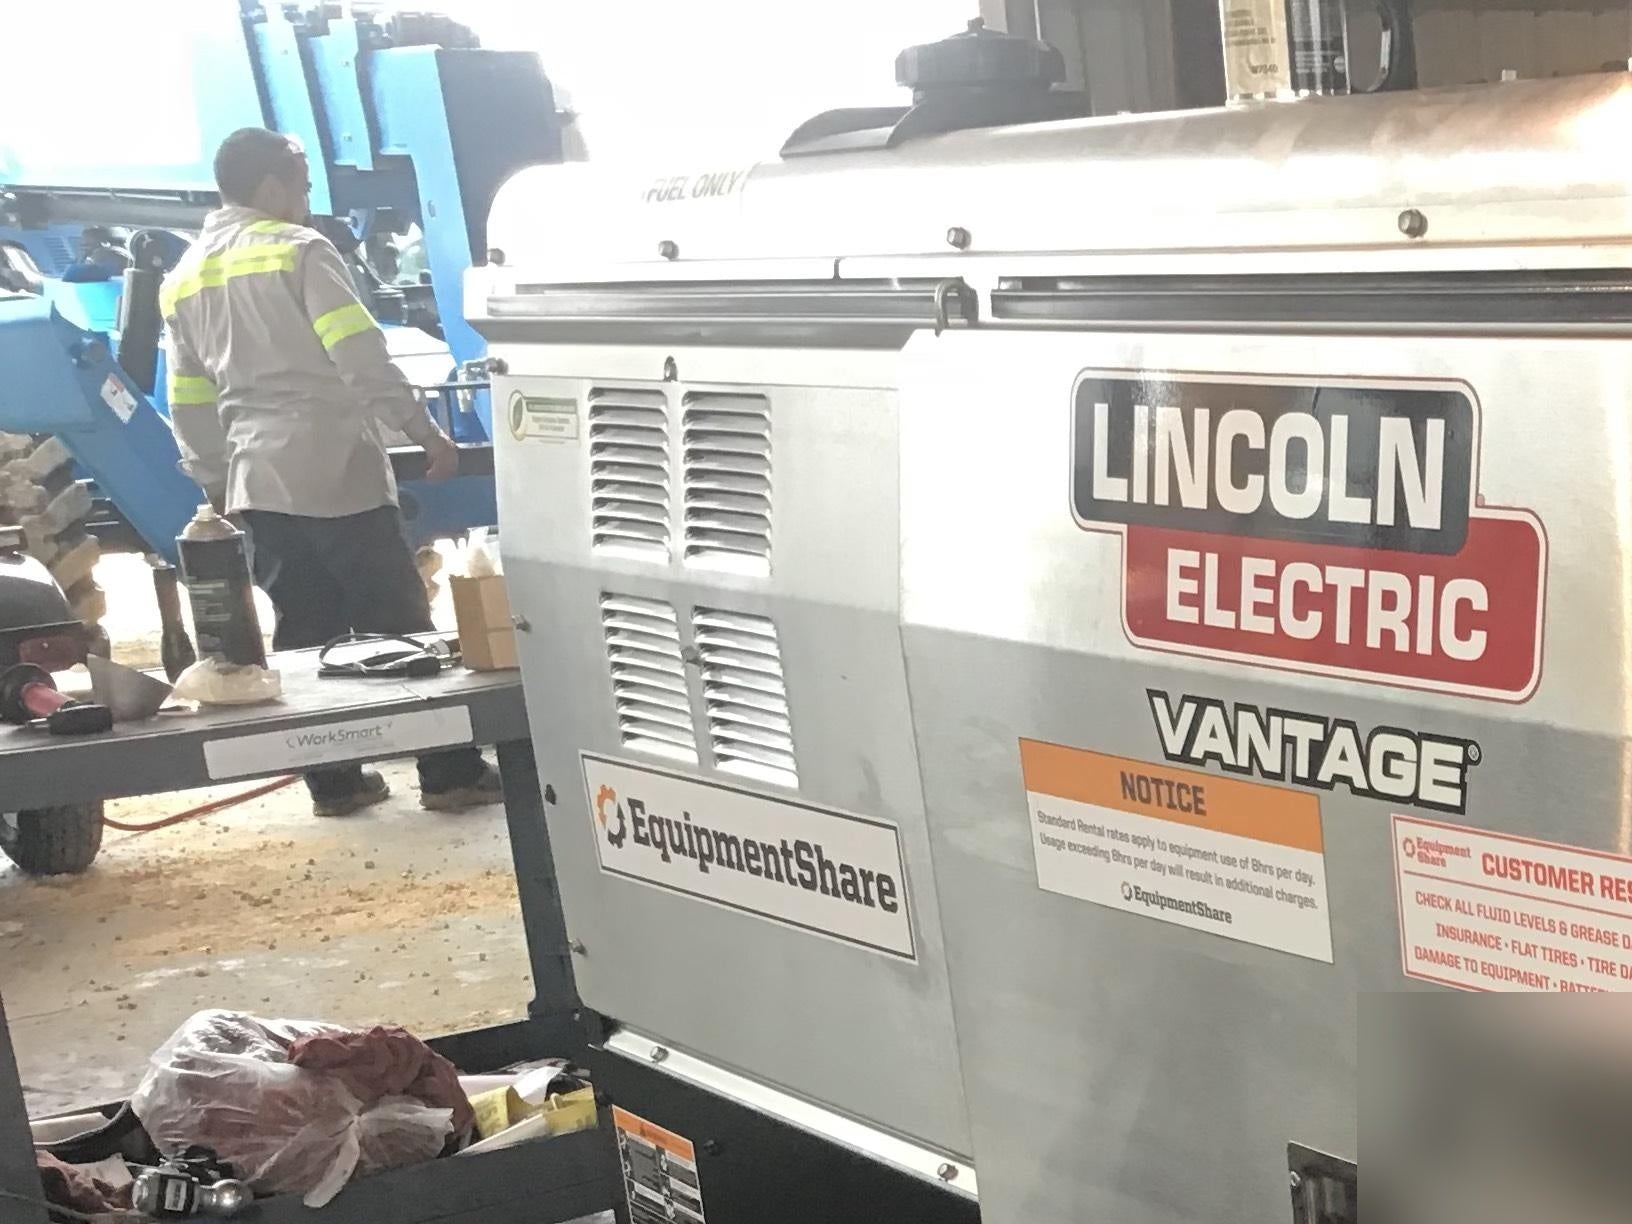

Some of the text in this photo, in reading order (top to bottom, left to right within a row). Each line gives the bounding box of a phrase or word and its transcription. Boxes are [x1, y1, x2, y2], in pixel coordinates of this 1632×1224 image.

[692, 170, 744, 198] ONLY
[1093, 402, 1446, 530] LINCOLN
[1166, 547, 1489, 662] ELECTRIC
[296, 725, 383, 747] WorkSmart
[1120, 771, 1207, 816] NOTICE
[627, 797, 899, 914] EquipmentShare
[1037, 810, 1076, 831] Standard
[1077, 819, 1105, 837] Rental
[1131, 834, 1155, 851] apply
[1157, 838, 1167, 852] to
[1169, 842, 1217, 864] equipment
[1220, 855, 1237, 868] use
[1239, 857, 1249, 869] of
[1251, 858, 1274, 876] 8hrs
[1276, 867, 1292, 880] per
[1295, 868, 1316, 887] day.
[1417, 837, 1471, 858] Equipment
[1417, 851, 1447, 867] Share
[1040, 833, 1318, 909] Usage exceeding 8hrs per day will result in additional charges.
[1481, 852, 1595, 897] CUSTOMER
[1133, 885, 1232, 923] EquipmentShare
[1415, 891, 1453, 912] CHECK
[1455, 899, 1474, 916] ALL
[1477, 903, 1511, 924] FLUID
[1514, 911, 1556, 934] LEVELS
[1559, 921, 1567, 936] &
[1571, 924, 1619, 948] GREASE
[1415, 946, 1461, 970] DAMAGE
[1463, 957, 1478, 973] TO
[1480, 962, 1550, 990] EQUIPMENT
[1436, 923, 1502, 950] INSURANCE
[1511, 940, 1538, 958] FLAT
[1540, 946, 1577, 968] TIRES
[1587, 957, 1616, 977] TIRE
